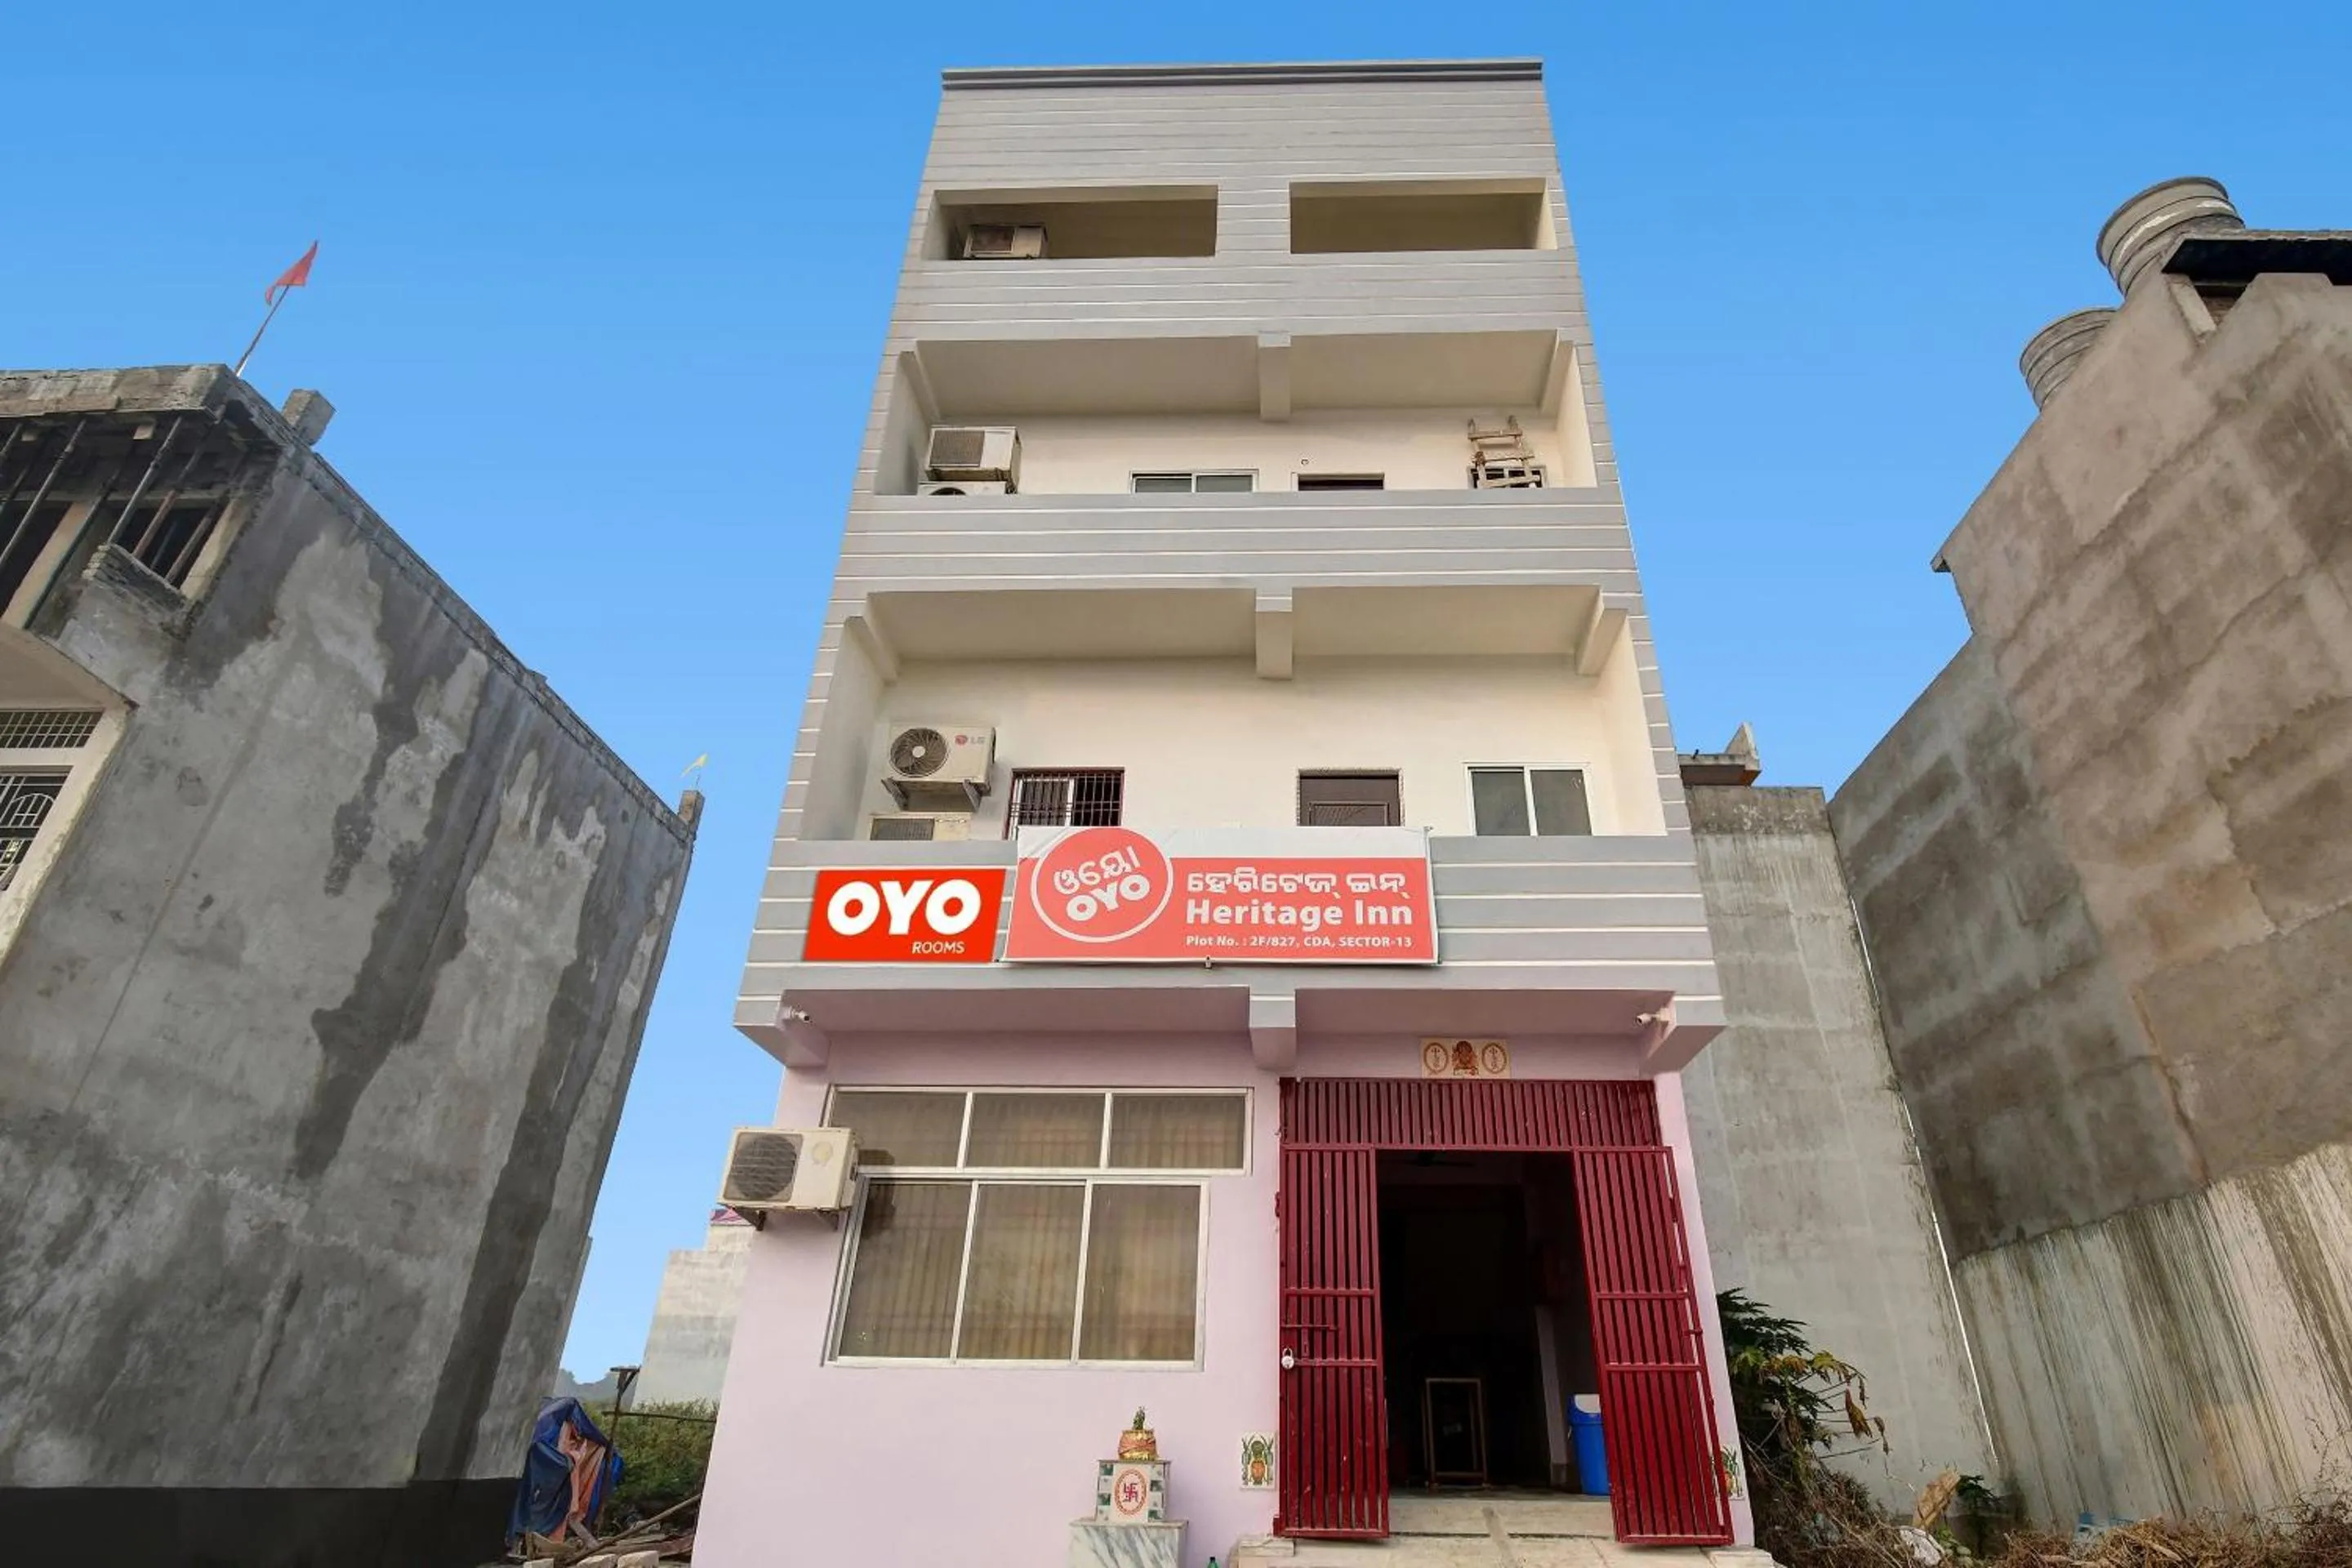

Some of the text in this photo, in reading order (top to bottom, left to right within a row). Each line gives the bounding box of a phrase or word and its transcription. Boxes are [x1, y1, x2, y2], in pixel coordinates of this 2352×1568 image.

[827, 879, 982, 936] OYO
[1066, 874, 1150, 921] OYO
[1186, 898, 1413, 933] Heritage Inn
[911, 941, 965, 955] ROOMS
[1186, 935, 1214, 947] Plot
[1217, 935, 1239, 947] No.
[1250, 936, 1299, 948] 2F/827,
[1303, 936, 1335, 948] CDA,
[1339, 937, 1412, 947] SECTOR-13
